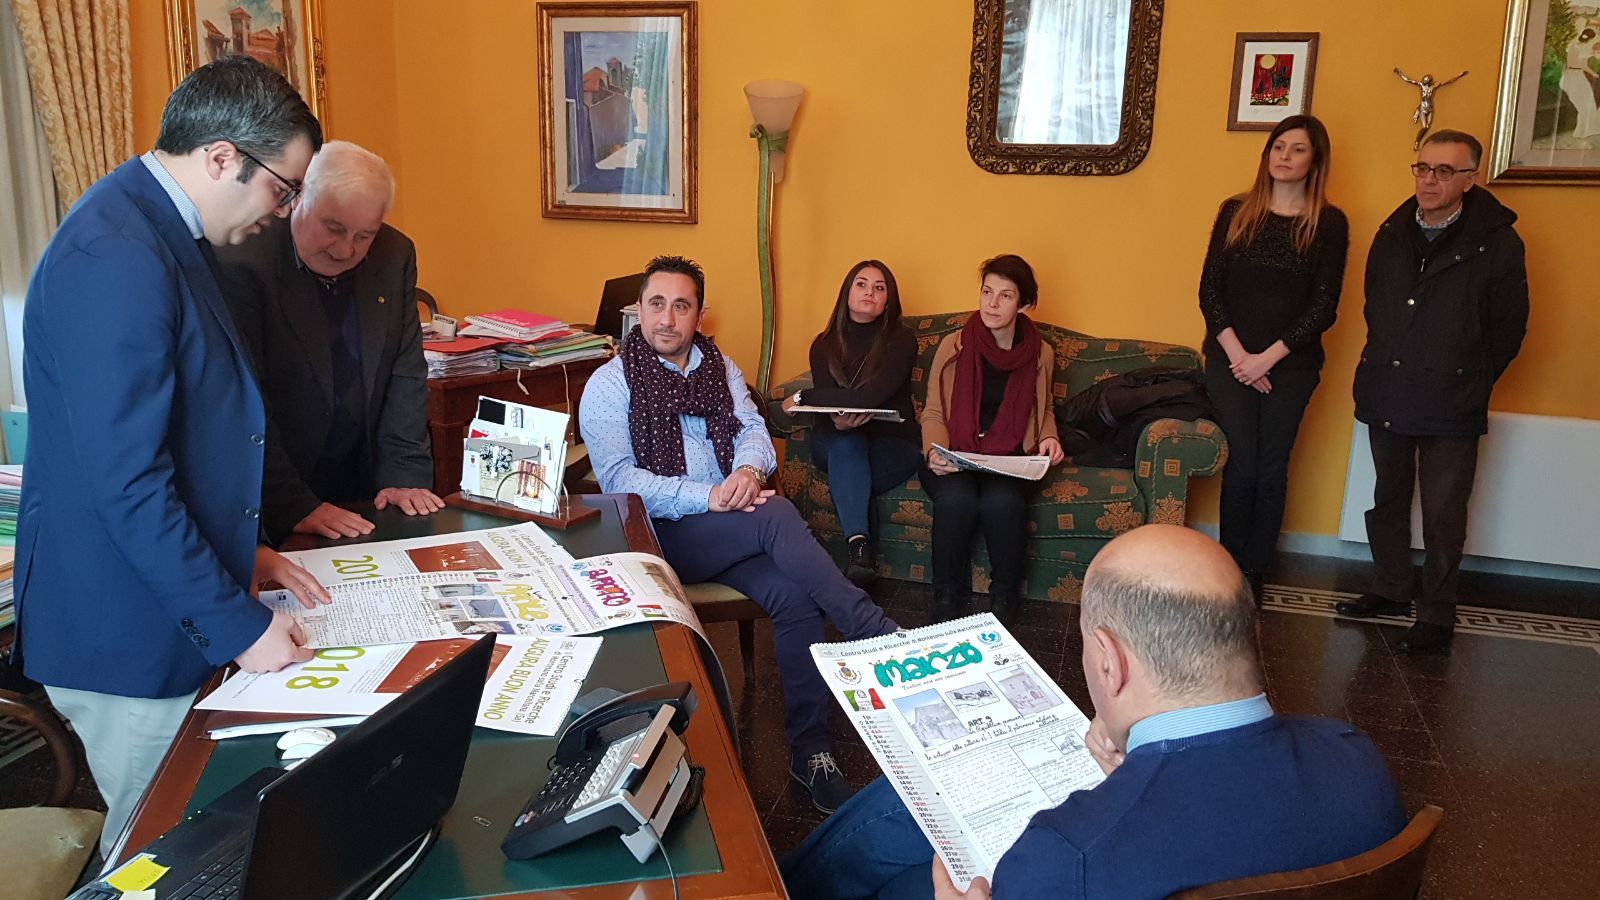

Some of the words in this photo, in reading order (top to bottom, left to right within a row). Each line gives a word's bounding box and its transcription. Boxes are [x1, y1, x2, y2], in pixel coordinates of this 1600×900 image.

[331, 555, 384, 581] 201
[517, 637, 551, 669] AUGURA
[840, 649, 861, 657] Centro
[862, 647, 878, 655] Studi
[884, 640, 911, 650] Ricerche
[285, 647, 366, 689] 018
[556, 655, 573, 678] Centro
[501, 668, 532, 693] BUON
[546, 675, 563, 690] Studi
[483, 692, 515, 720] ANNO
[525, 696, 551, 724] Ricerche
